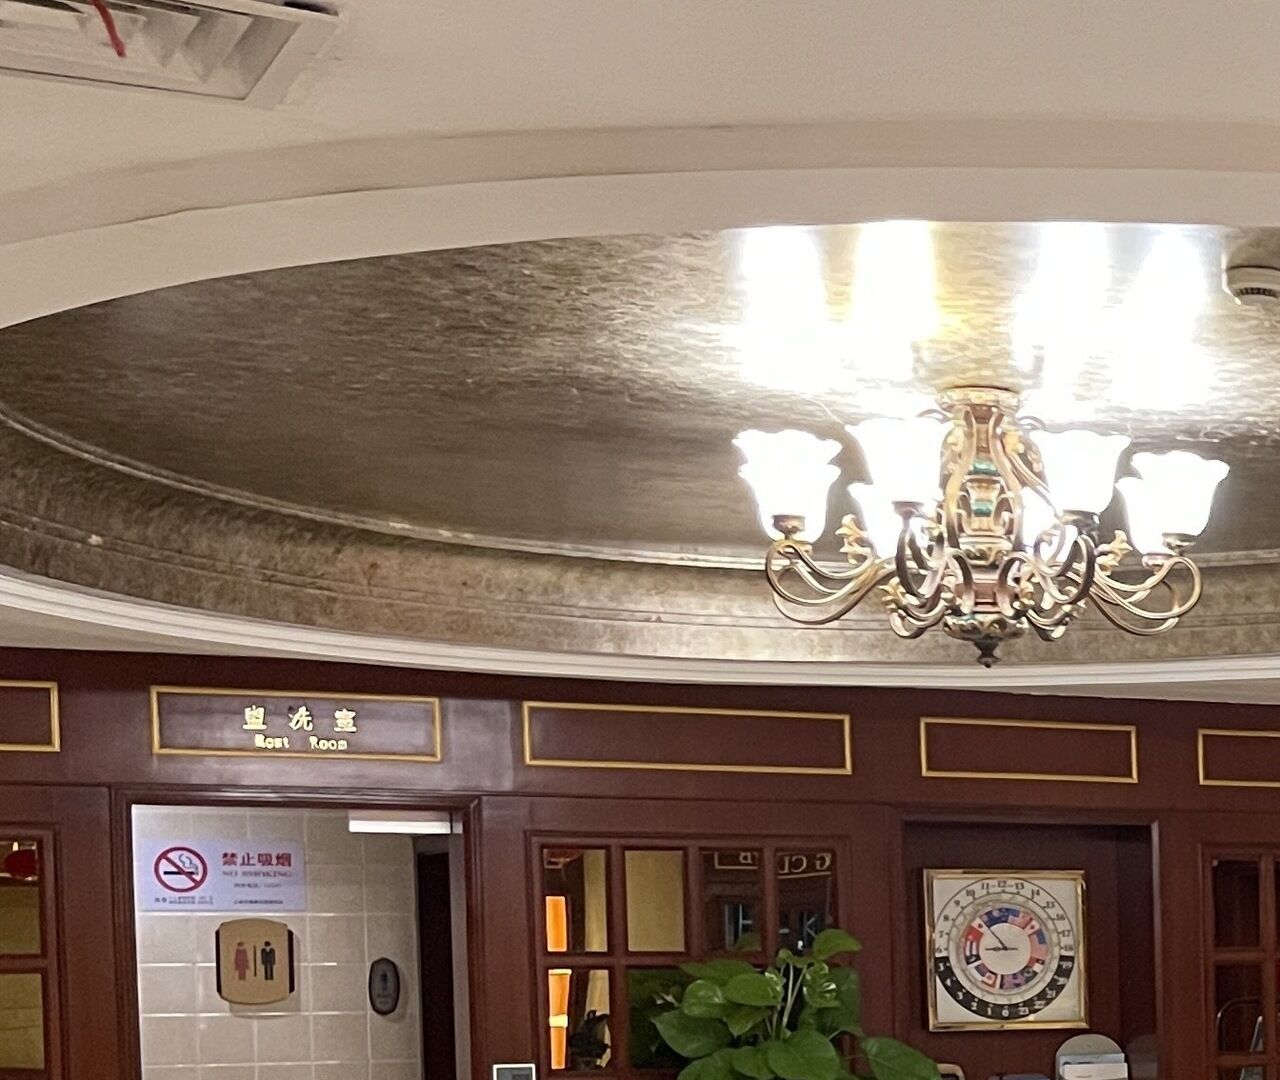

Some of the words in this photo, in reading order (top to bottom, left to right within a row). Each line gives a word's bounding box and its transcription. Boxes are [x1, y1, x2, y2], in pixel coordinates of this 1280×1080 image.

[309, 736, 347, 750] Room
[222, 853, 292, 867] 禁止吸烟
